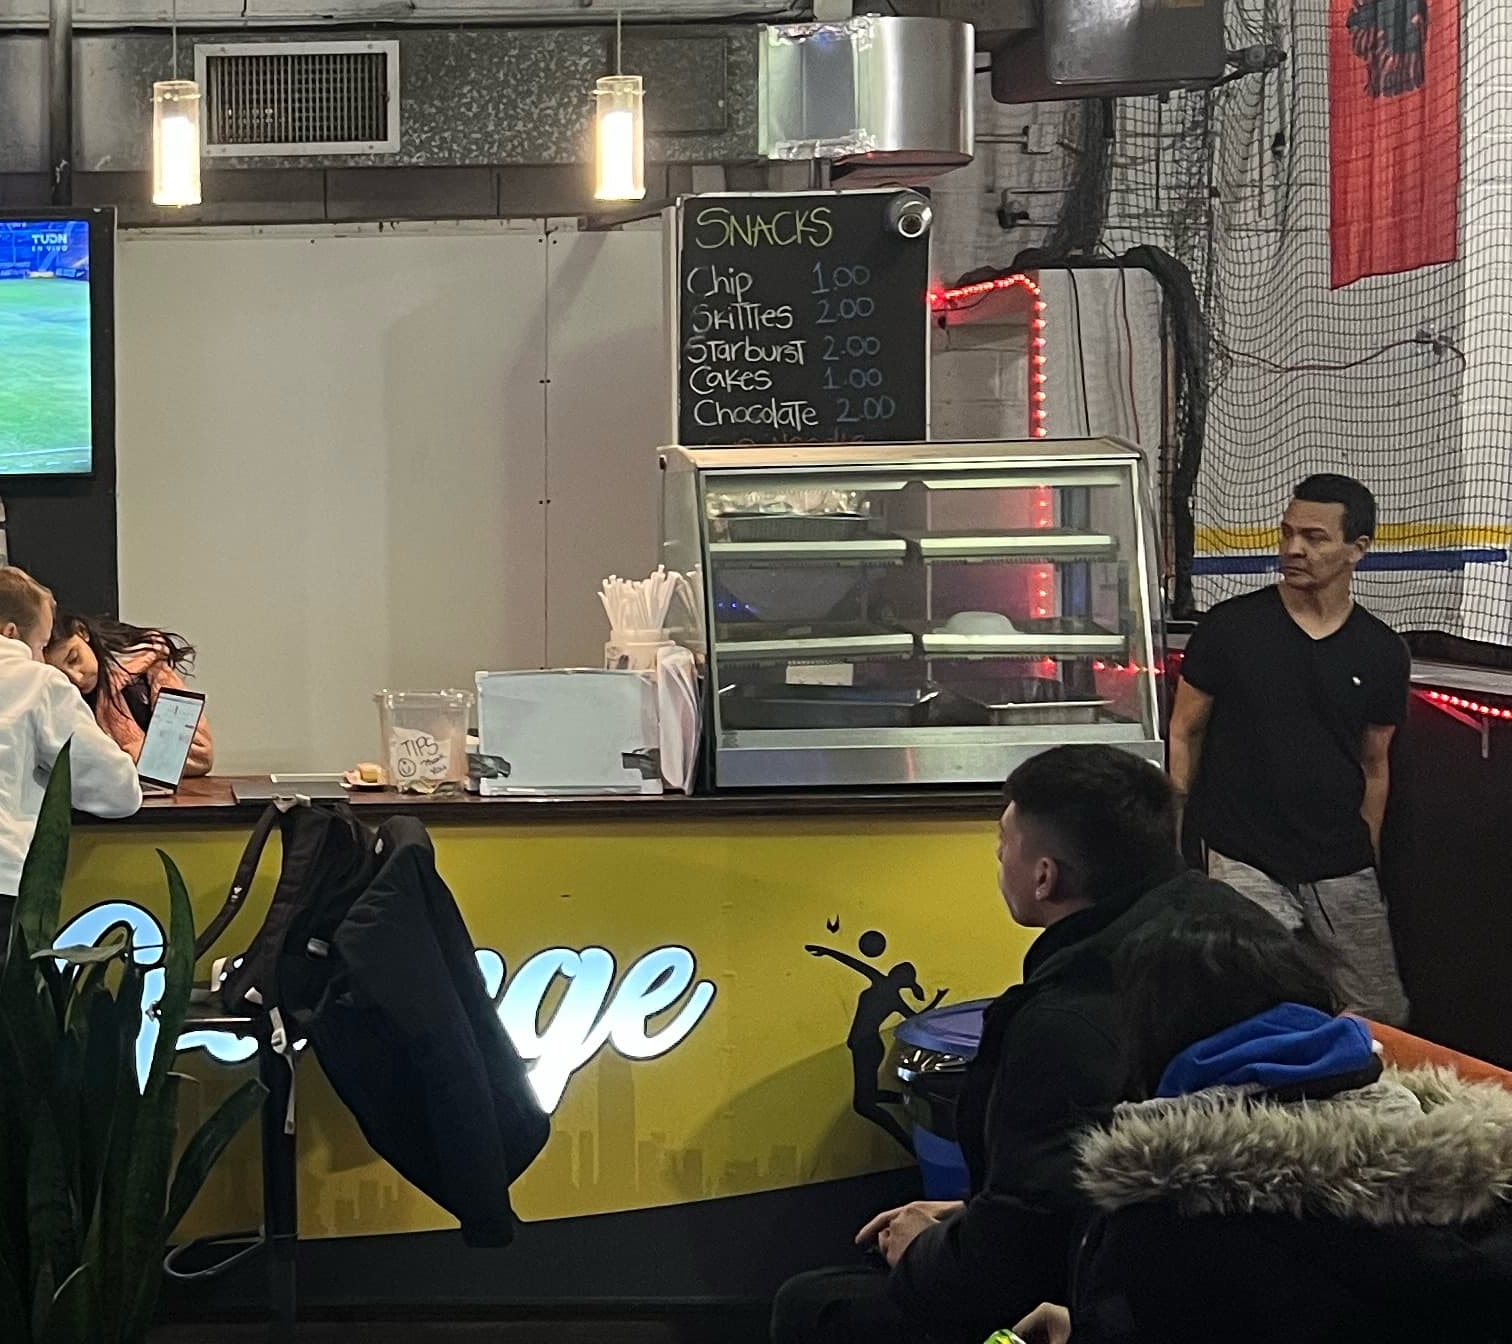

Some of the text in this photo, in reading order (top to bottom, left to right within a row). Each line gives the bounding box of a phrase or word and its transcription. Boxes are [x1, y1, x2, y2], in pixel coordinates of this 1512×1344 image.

[31, 234, 67, 244] TUDN
[695, 207, 833, 249] SNACKS
[687, 261, 871, 306] Chip 1.00
[816, 297, 875, 325] 2.00
[687, 336, 881, 365] Starburst 2.00
[689, 365, 773, 395] Cakes
[694, 398, 896, 432] Chocolate 2.00
[400, 736, 439, 757] TIPS
